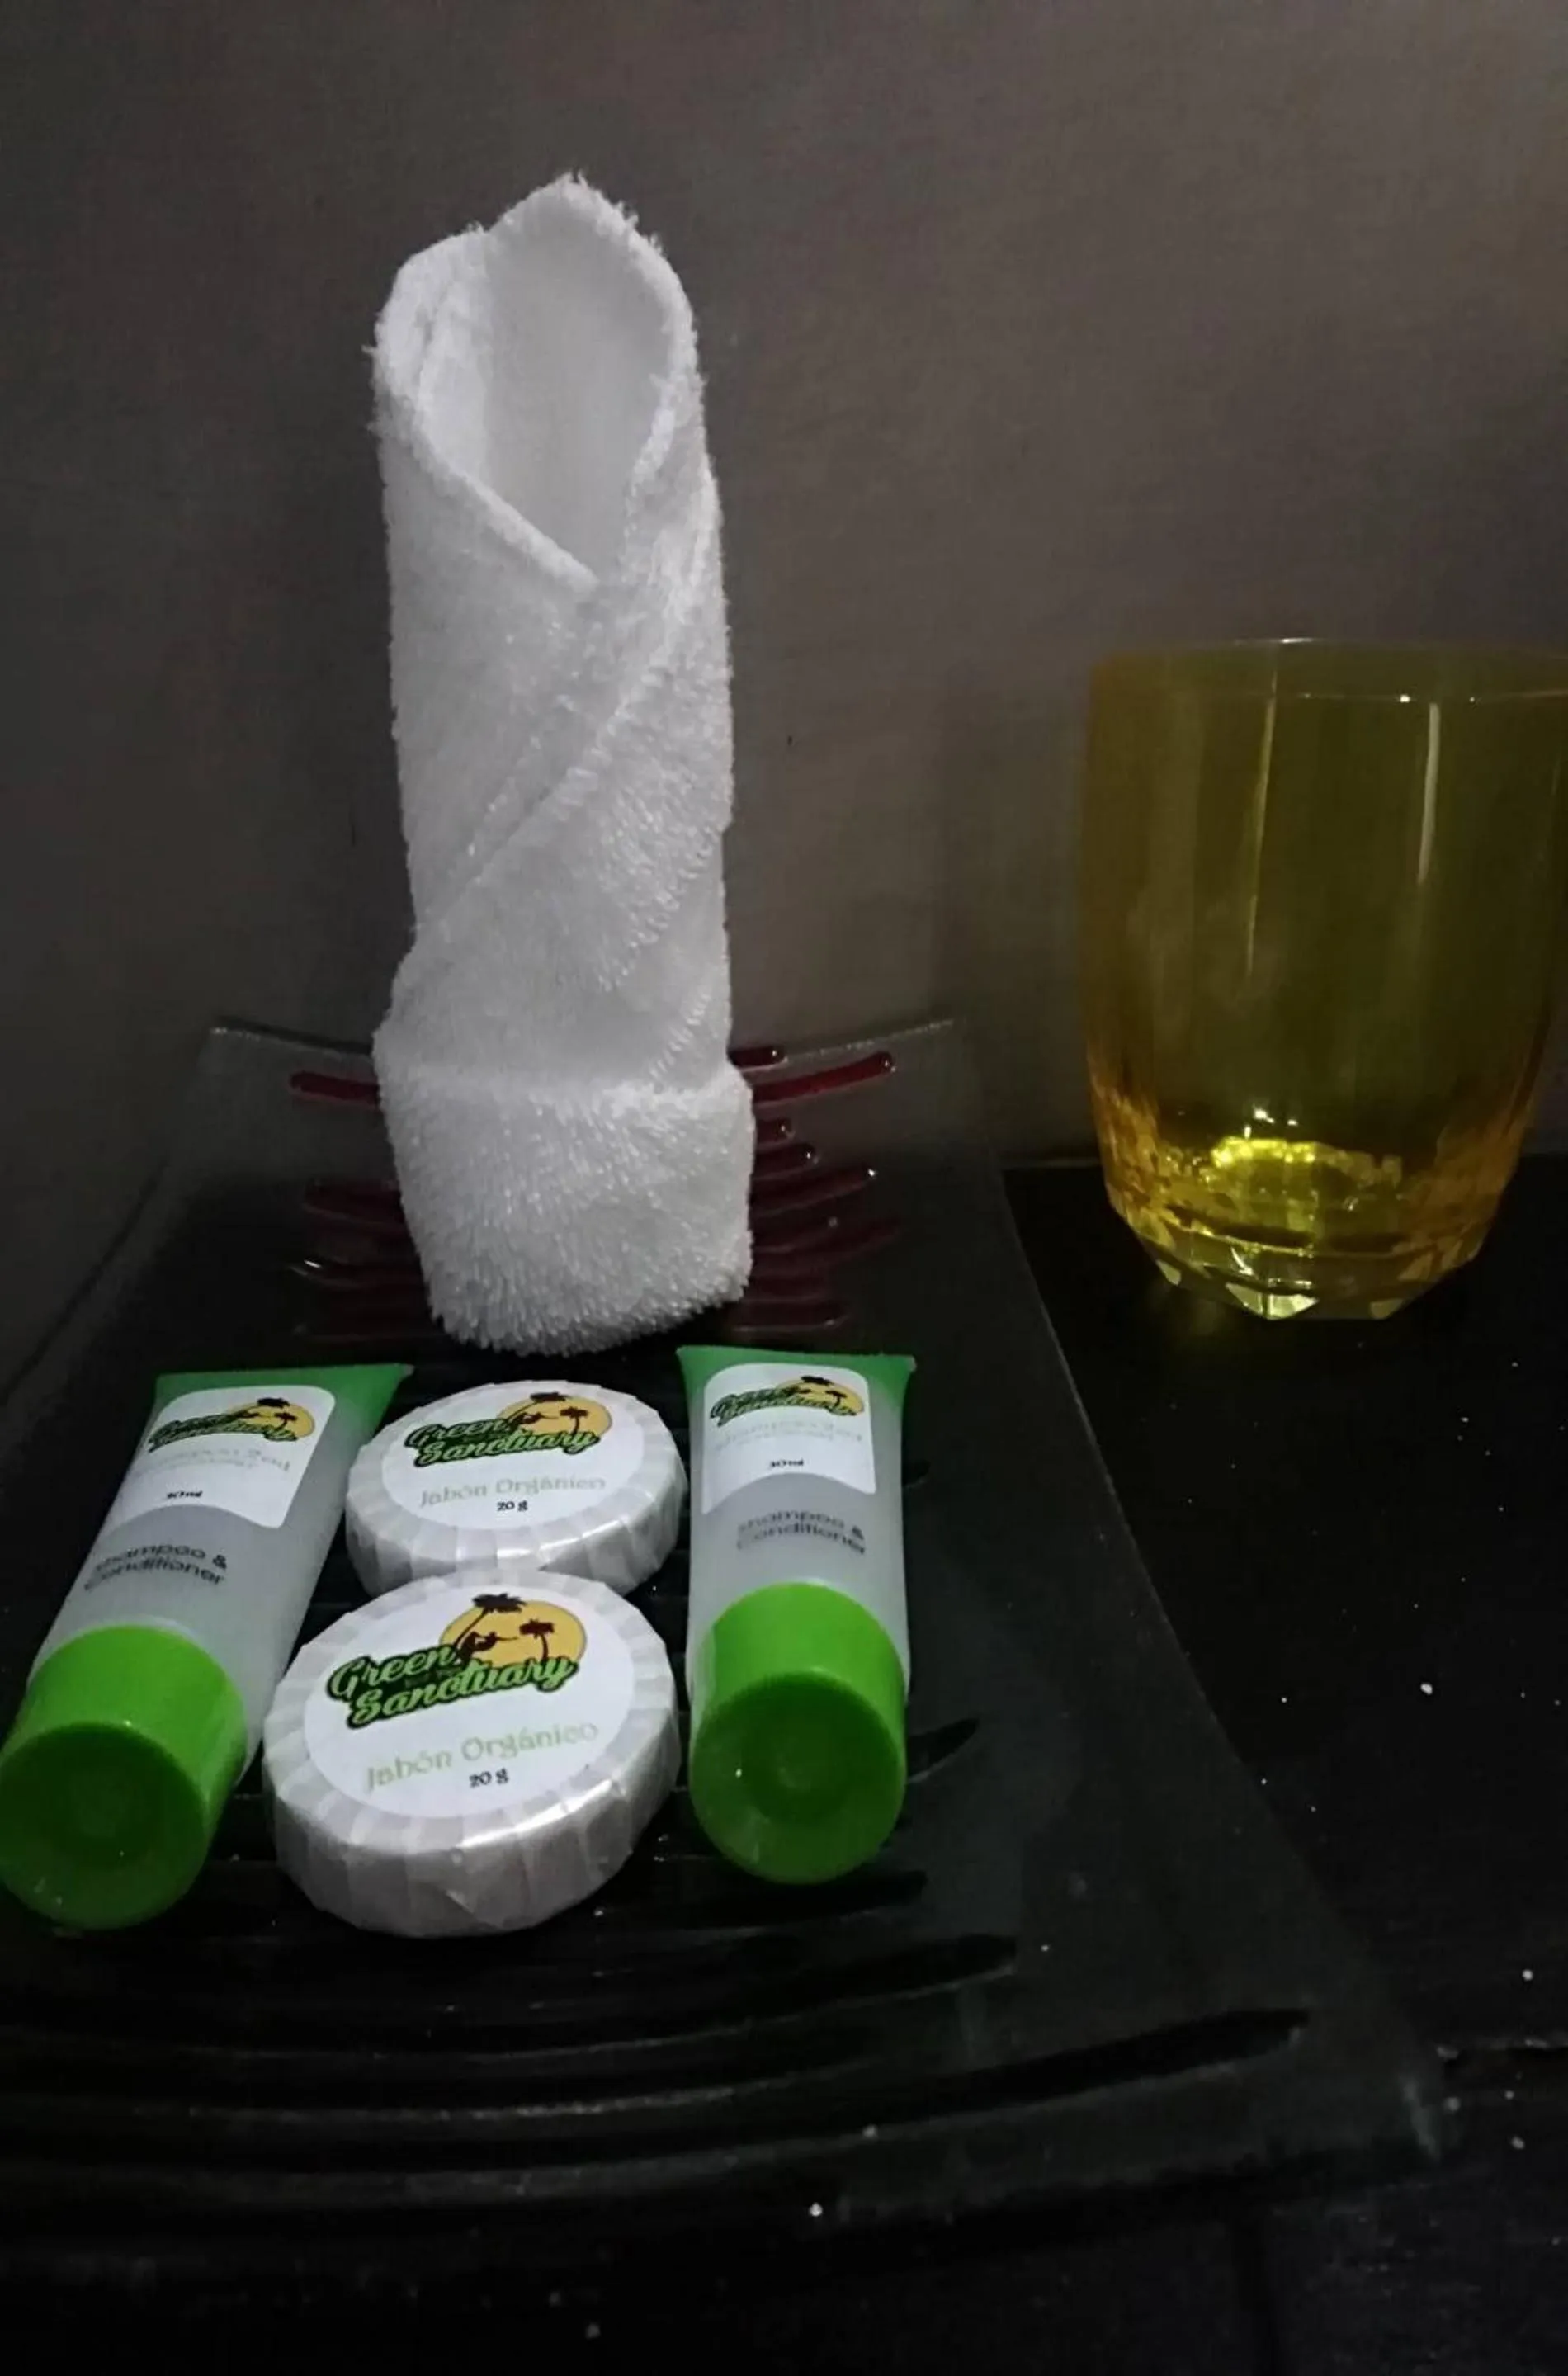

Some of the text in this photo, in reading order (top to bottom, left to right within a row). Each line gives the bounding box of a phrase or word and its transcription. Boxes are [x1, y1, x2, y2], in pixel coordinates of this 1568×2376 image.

[404, 1418, 509, 1449] Green
[413, 1425, 601, 1467] Sanctuary
[420, 1480, 488, 1509] Jabón
[496, 1500, 528, 1513] 20 g
[211, 1552, 228, 1571] &
[327, 1644, 459, 1703] Green
[347, 1654, 579, 1729] Sanctuary
[366, 1721, 599, 1792] Jabón Orgánico
[469, 1768, 510, 1788] 20 g
